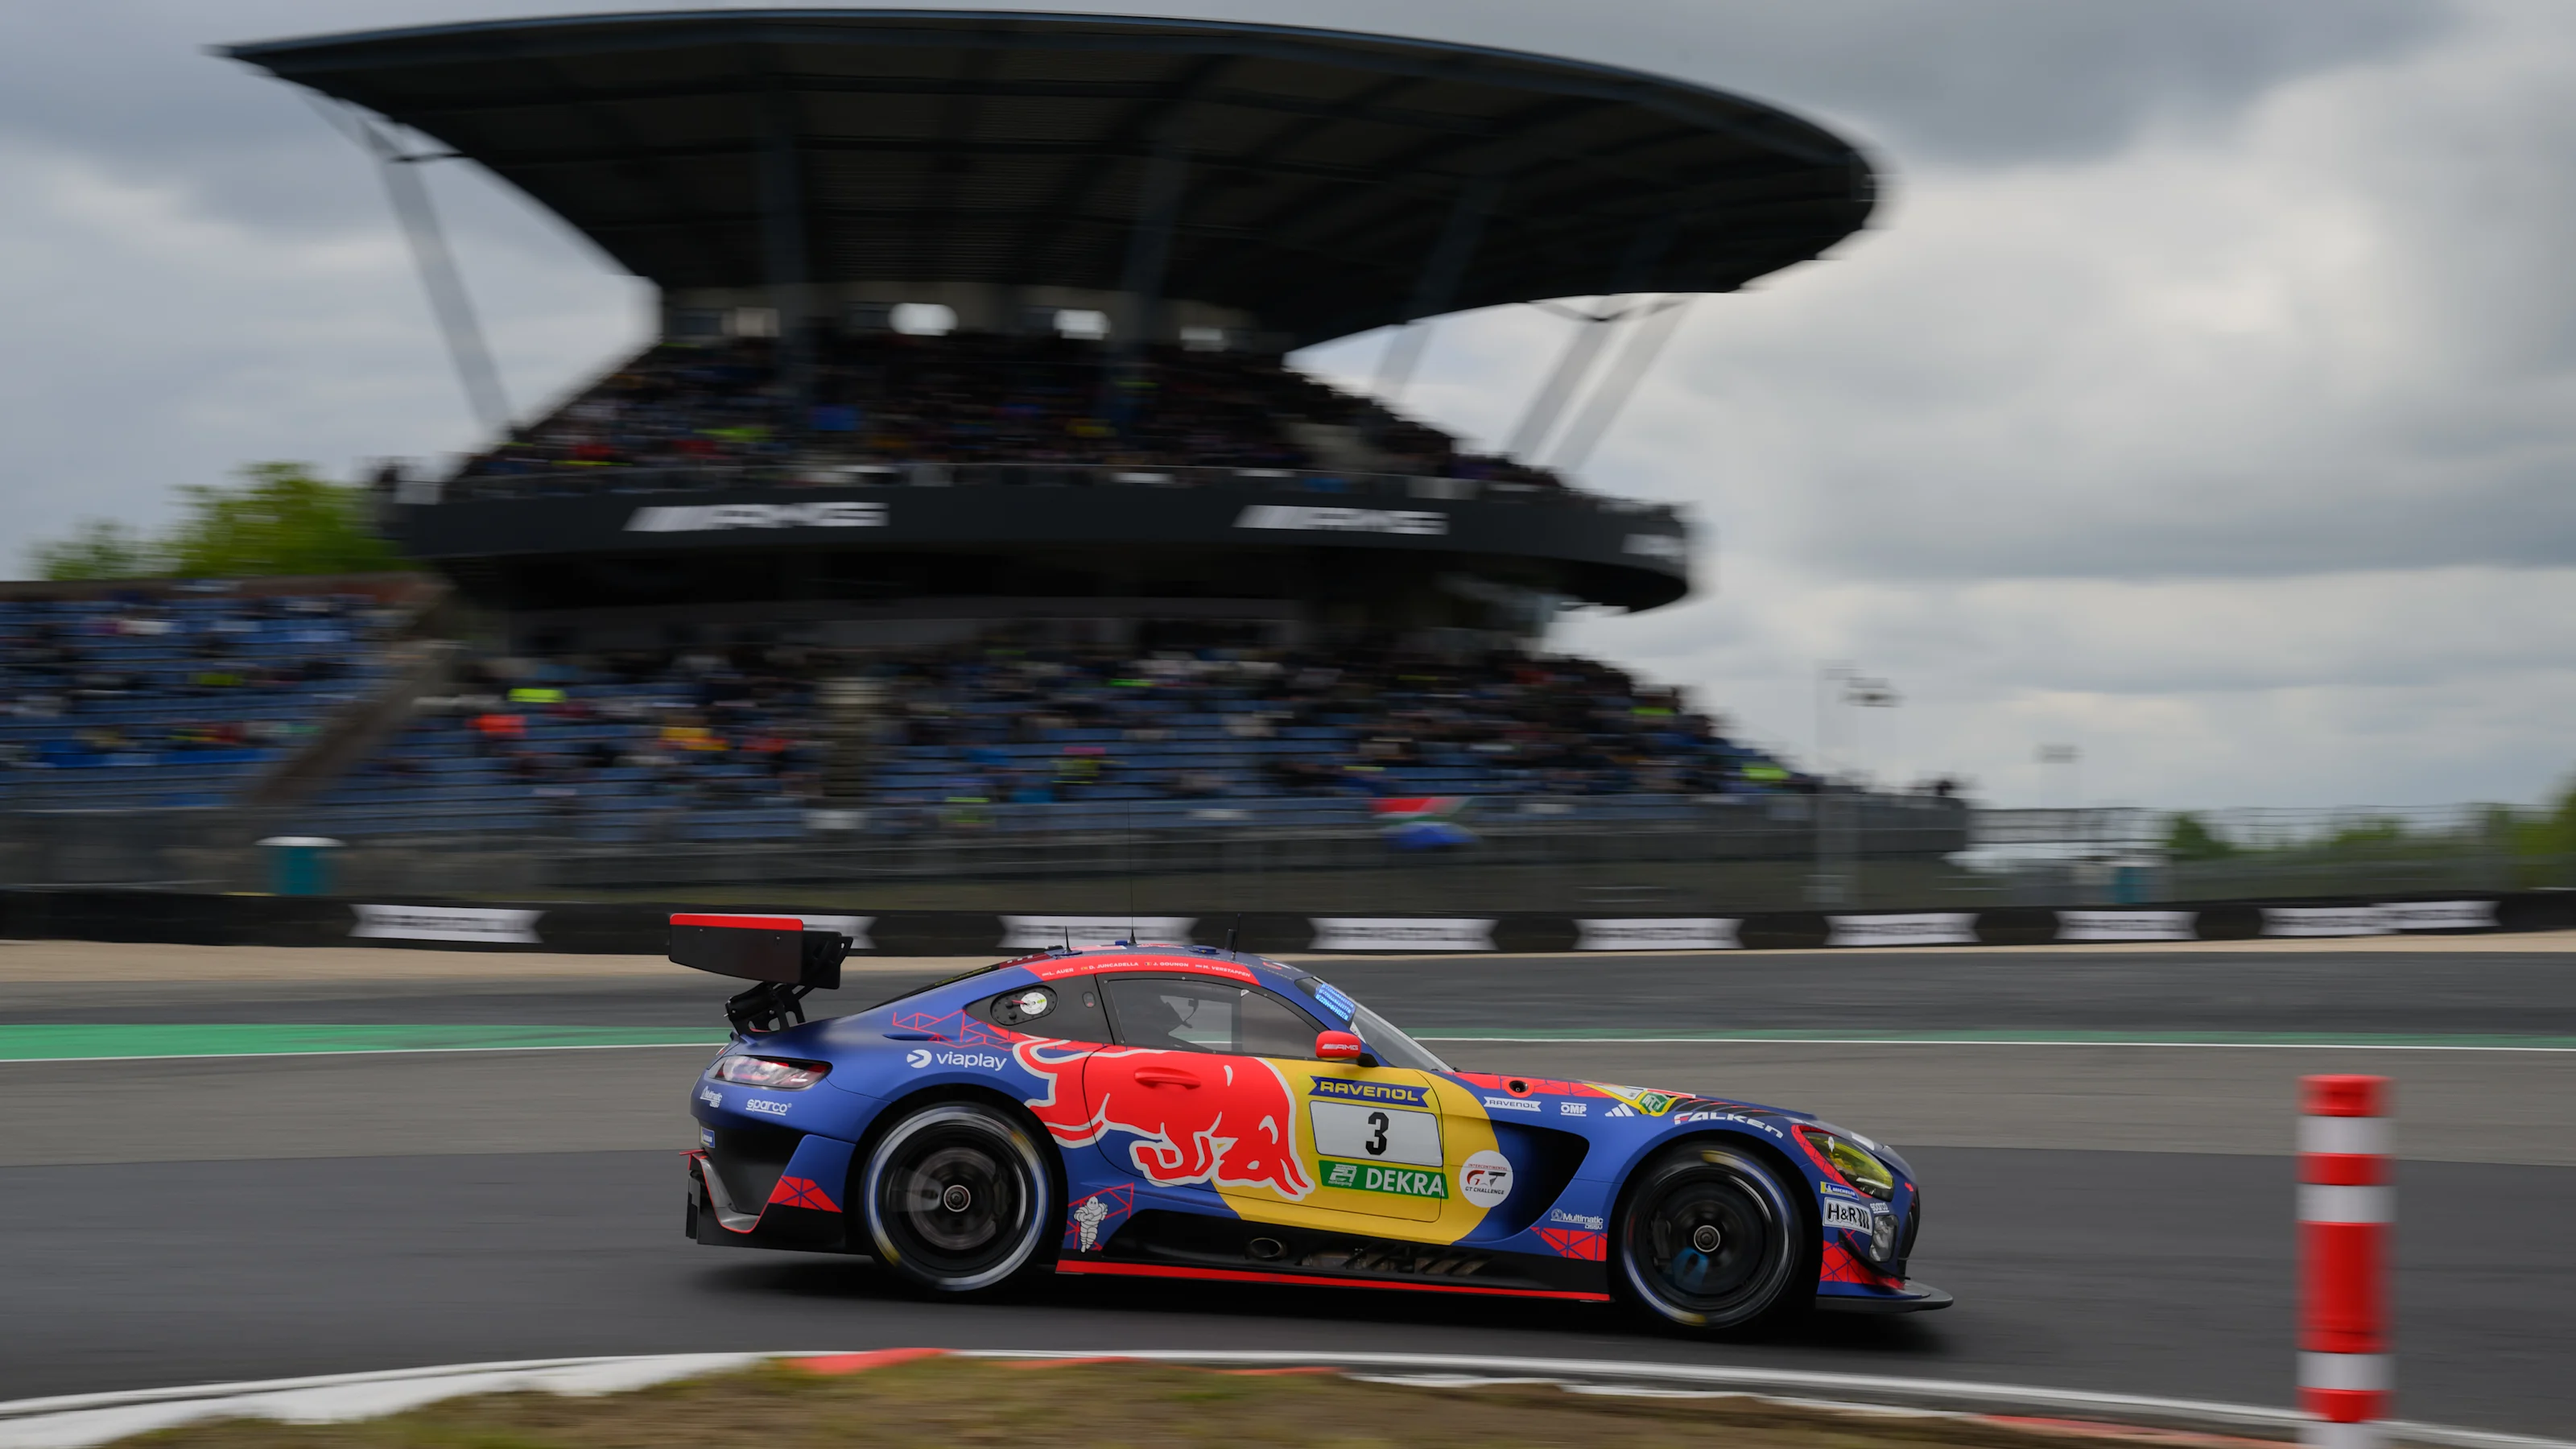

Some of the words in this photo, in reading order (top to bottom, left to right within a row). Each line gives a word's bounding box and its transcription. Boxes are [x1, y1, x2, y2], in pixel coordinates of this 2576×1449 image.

[1096, 961, 1138, 969] JUNCADELLA
[1212, 966, 1251, 978] VERSTAPPEN
[936, 1051, 1008, 1071] viaplay
[1319, 1080, 1419, 1102] RAVENOL
[1489, 1099, 1536, 1108] RAVENOL
[1560, 1104, 1587, 1115] OMP
[1674, 1111, 1784, 1139] FALKEN
[1365, 1111, 1389, 1156] 3
[1468, 1163, 1508, 1171] INTERCONTINENTAL
[1365, 1167, 1445, 1197] DEKRA
[1473, 1187, 1505, 1195] CHALLENGE
[1831, 1187, 1856, 1197] MICHELIN
[1563, 1212, 1604, 1224] Multimatic
[1827, 1203, 1857, 1223] H&R
